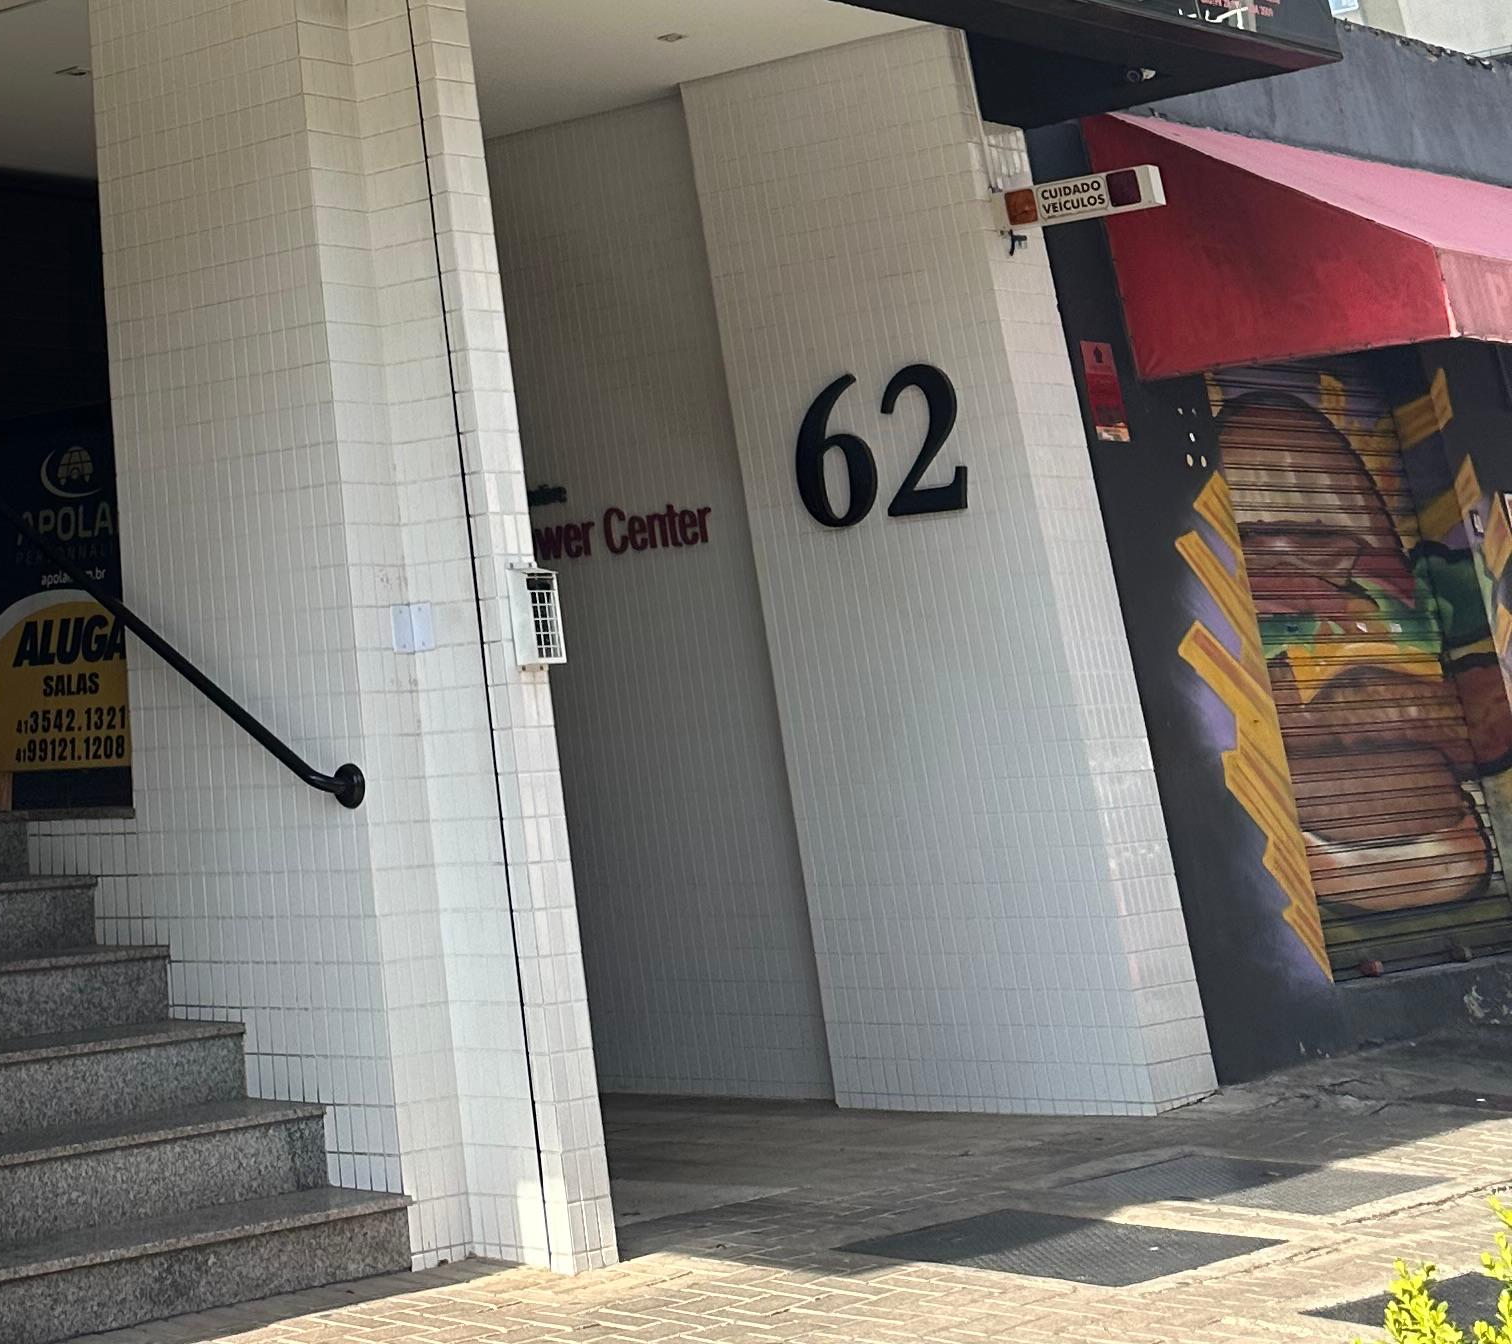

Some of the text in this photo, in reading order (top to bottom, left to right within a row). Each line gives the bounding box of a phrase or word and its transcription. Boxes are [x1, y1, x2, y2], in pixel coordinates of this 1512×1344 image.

[1041, 180, 1101, 200] CUIDADO
[795, 363, 968, 528] 62
[603, 504, 712, 555] Center
[13, 614, 126, 667] ALUGA
[43, 672, 100, 697] SALAS
